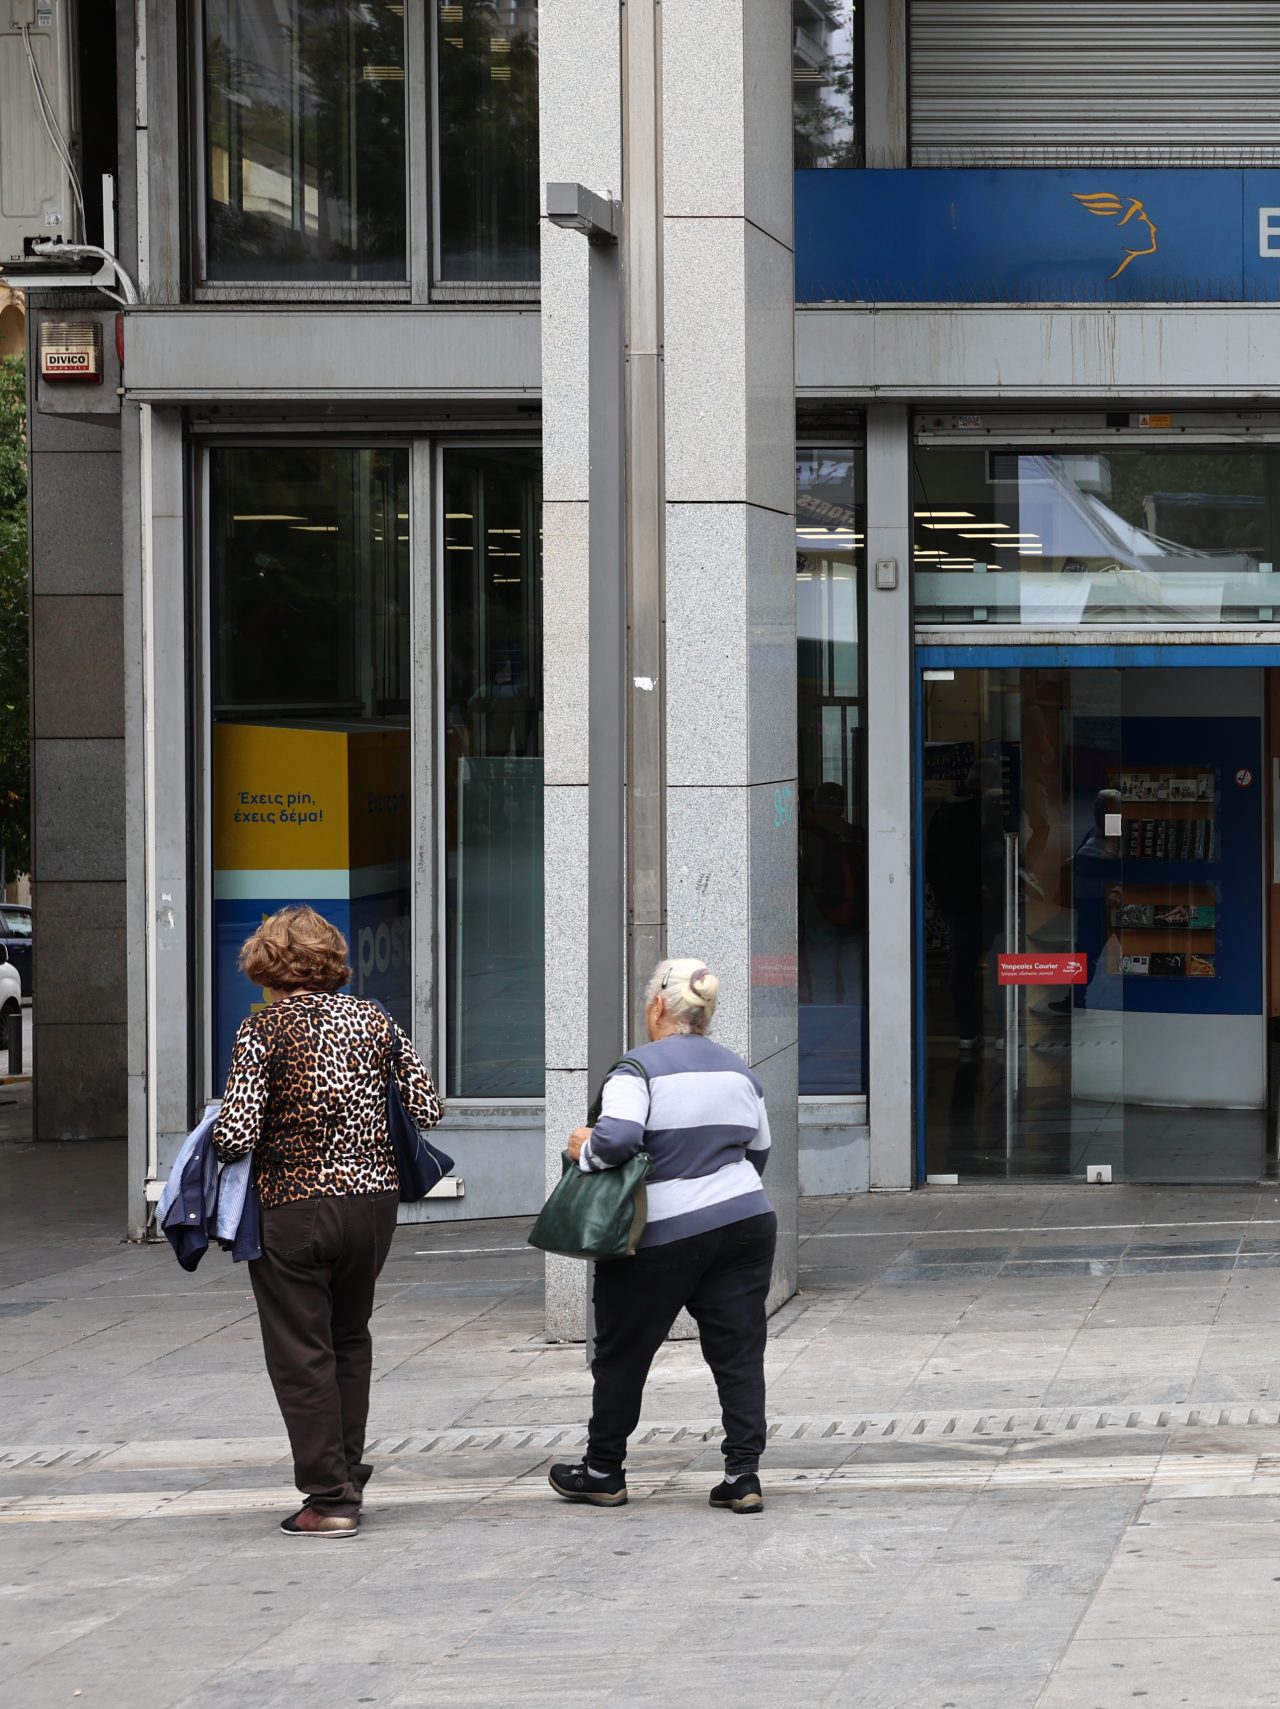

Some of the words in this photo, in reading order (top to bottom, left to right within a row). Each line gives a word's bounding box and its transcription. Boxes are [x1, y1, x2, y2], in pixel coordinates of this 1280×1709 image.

[49, 355, 86, 365] DIVICO
[238, 791, 284, 806] Έχεις
[287, 791, 316, 808] pin,
[233, 810, 276, 824] έχεις
[279, 809, 323, 826] δέμα!
